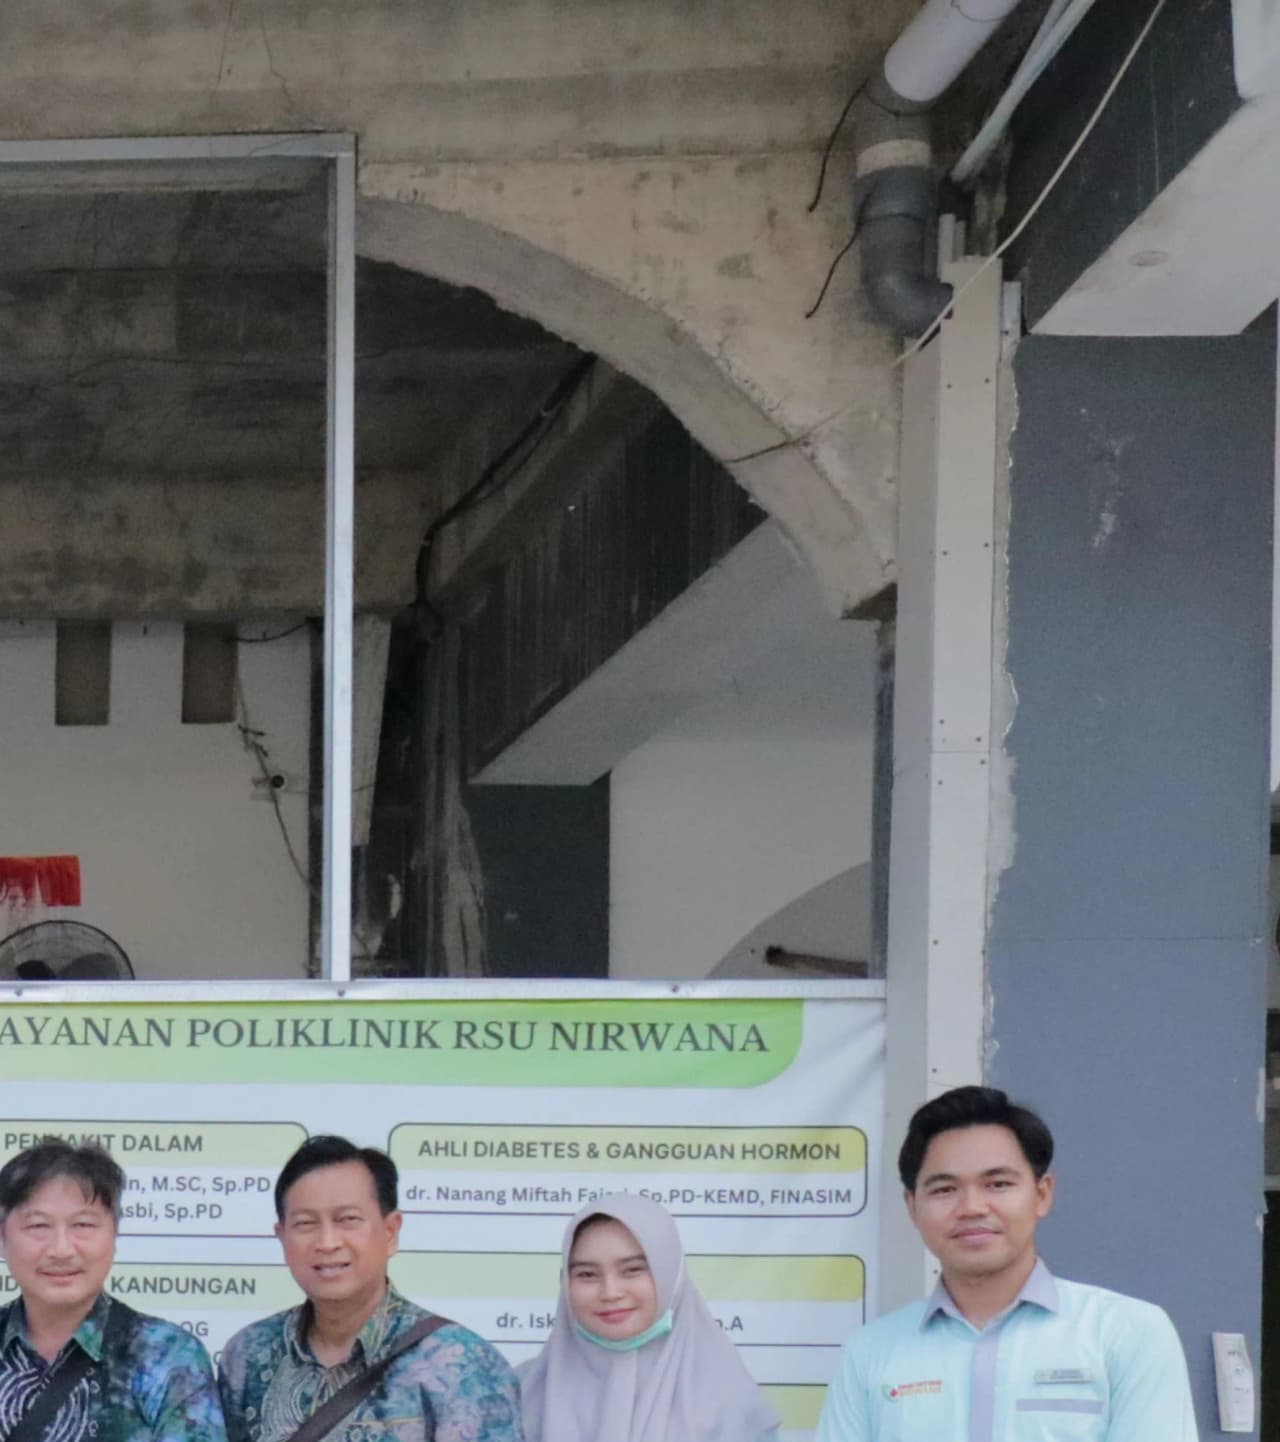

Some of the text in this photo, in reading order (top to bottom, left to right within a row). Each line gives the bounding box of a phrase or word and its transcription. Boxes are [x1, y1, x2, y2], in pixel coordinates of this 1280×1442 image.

[186, 1018, 440, 1050] POLIKLINIK
[453, 1020, 537, 1051] RSU
[549, 1021, 769, 1054] NIRWANA
[122, 1134, 203, 1152] DALAM
[418, 1140, 841, 1161] AHLI DIABETES & GANGGUAN HORMON
[212, 1176, 271, 1197] Sp.PD
[405, 1185, 431, 1201] dr.
[436, 1186, 507, 1206] Nanang
[512, 1187, 572, 1204] Miftah
[770, 1189, 852, 1205] FINASIM
[165, 1203, 223, 1222] Sp.PD
[111, 1276, 256, 1295] KANDUNGAN
[496, 1313, 523, 1329] dr.
